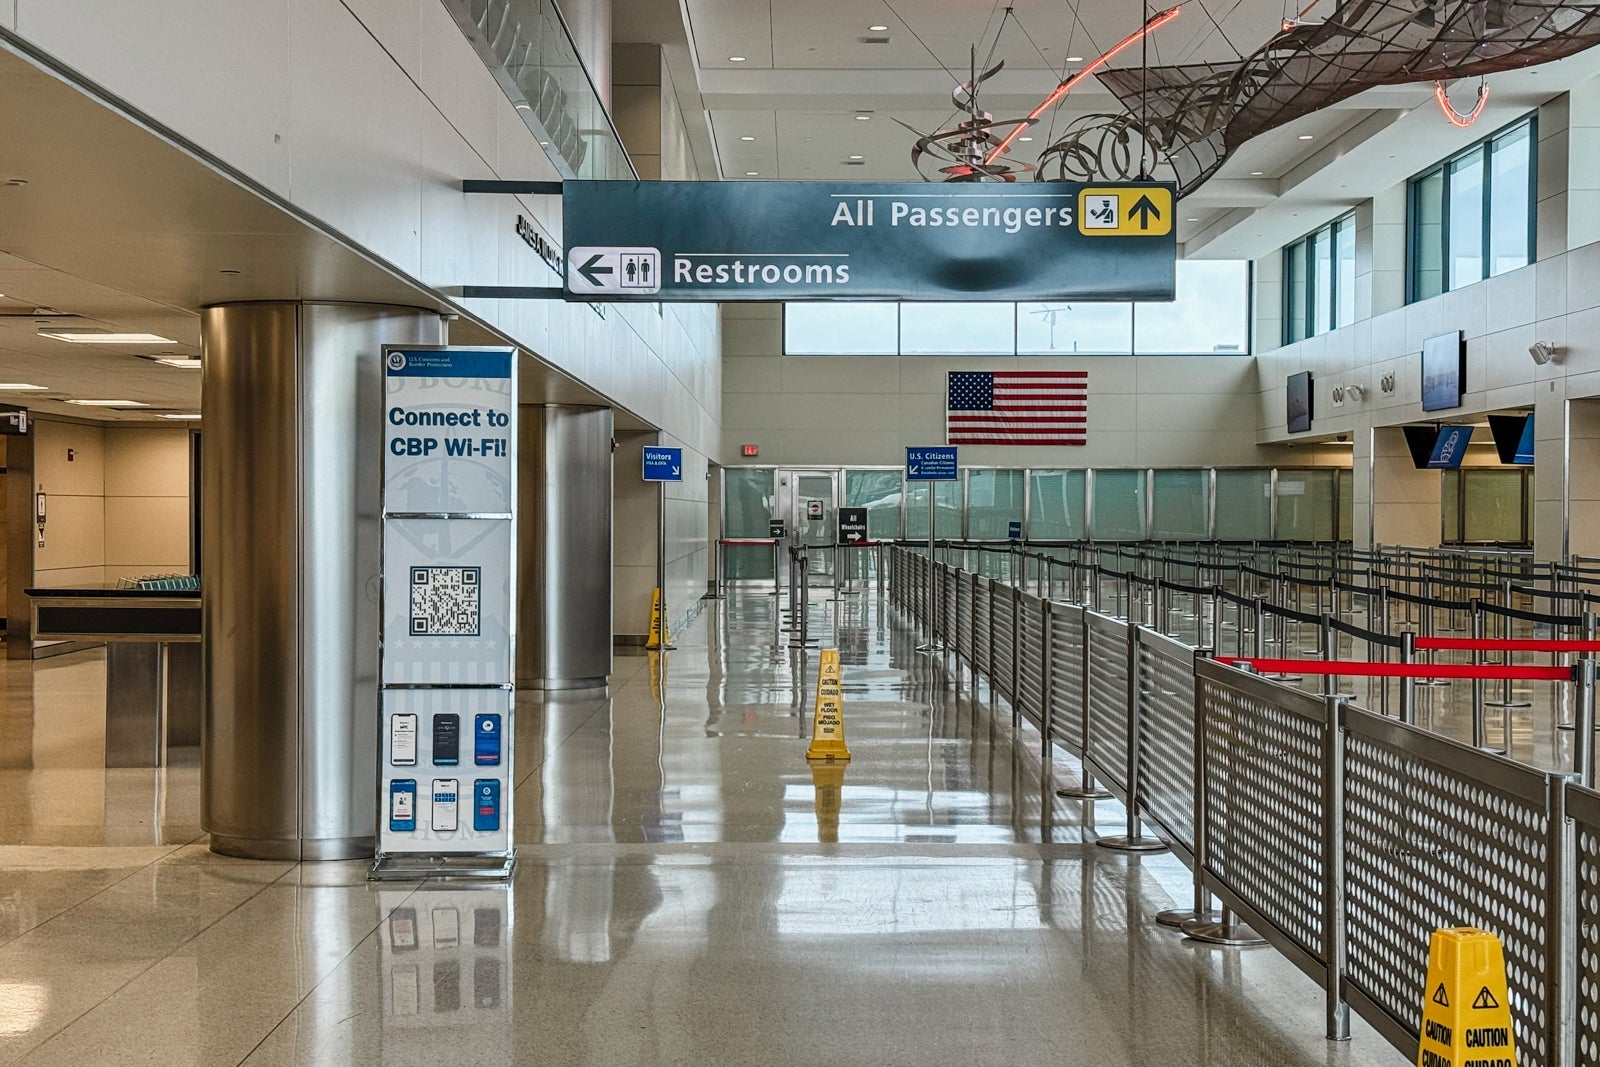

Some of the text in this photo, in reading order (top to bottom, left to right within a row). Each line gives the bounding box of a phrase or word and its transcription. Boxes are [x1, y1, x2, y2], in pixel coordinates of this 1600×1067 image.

[831, 200, 1073, 233] All Passengers
[674, 258, 850, 284] Restrooms
[389, 407, 509, 427] Connect to
[390, 438, 507, 457] CBP Wi-Fi!
[1425, 1019, 1452, 1047] CAUTION
[1466, 1027, 1508, 1048] CAUTION
